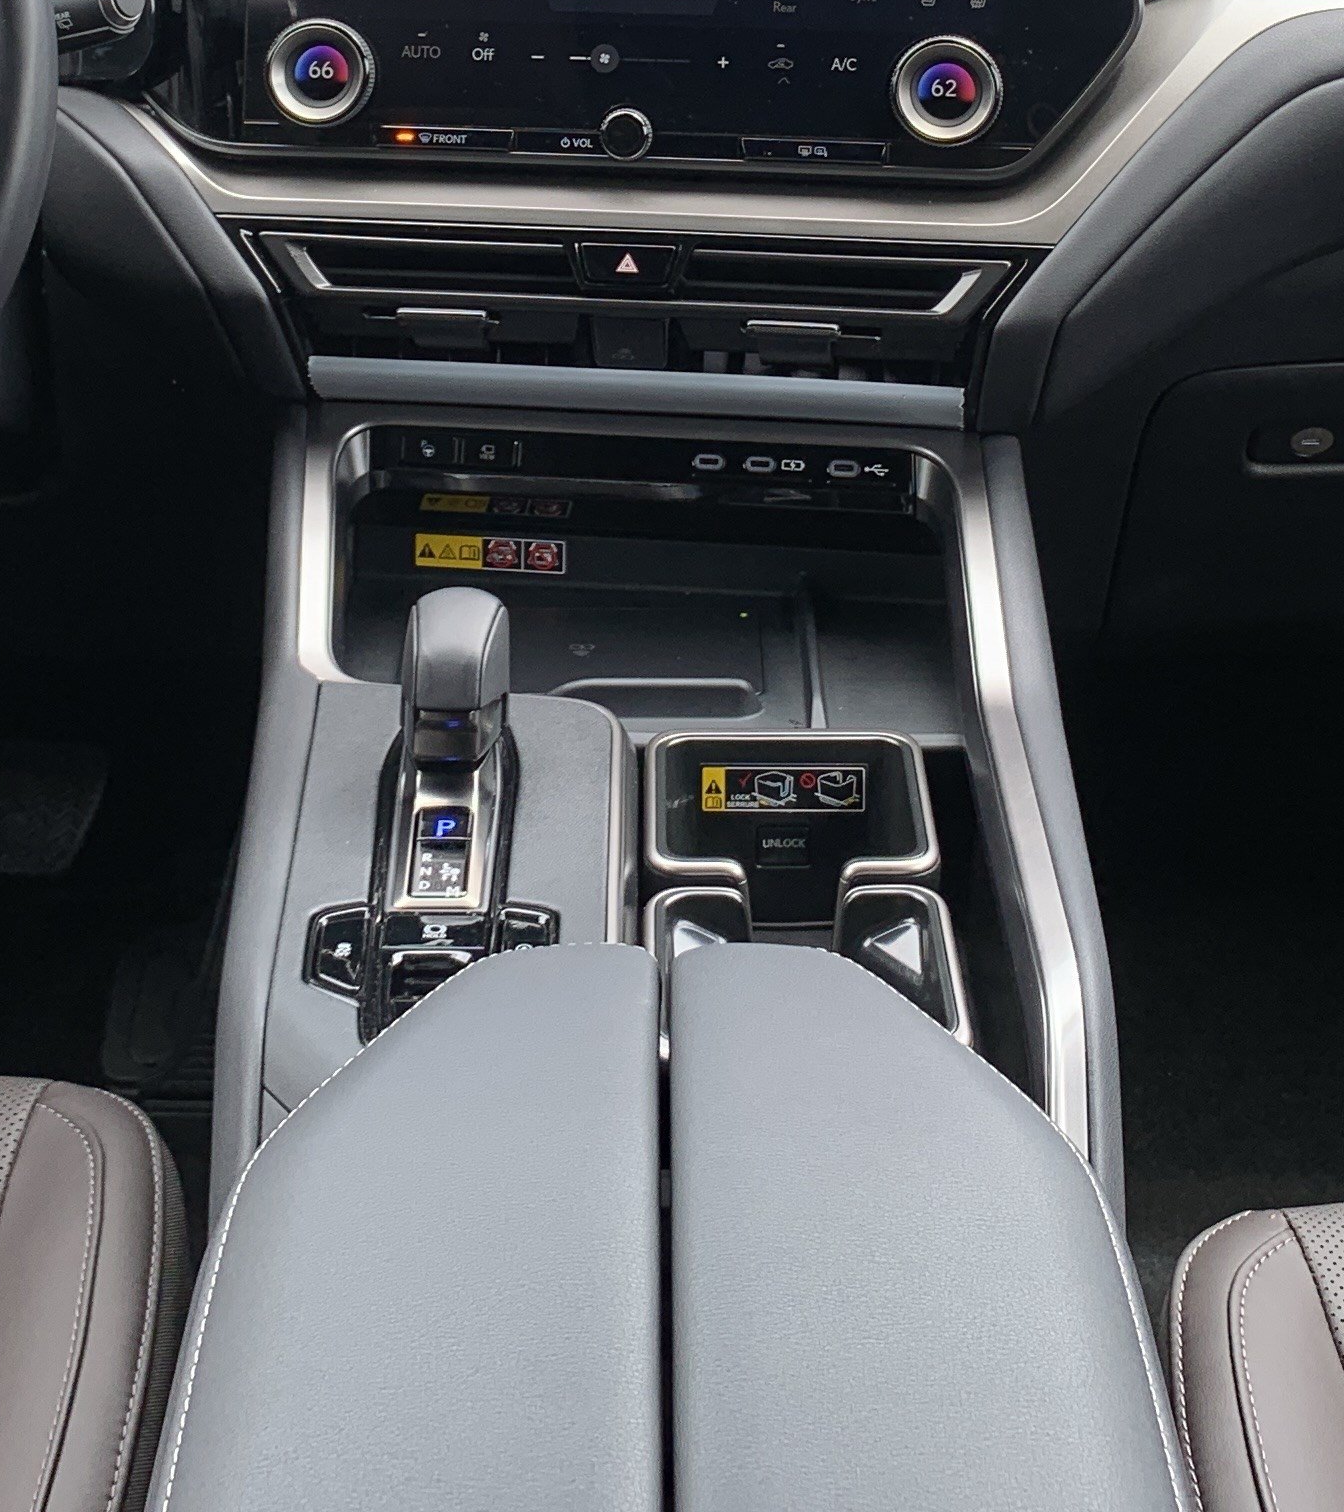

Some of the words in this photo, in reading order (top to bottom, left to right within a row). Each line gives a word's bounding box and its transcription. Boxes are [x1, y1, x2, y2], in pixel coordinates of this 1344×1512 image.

[773, 1, 798, 13] Rear
[401, 45, 442, 59] AUTO
[471, 47, 496, 62] Off
[307, 60, 335, 80] 66
[830, 57, 858, 72] A/C
[930, 78, 958, 98] 62
[432, 133, 468, 144] FRONT
[571, 138, 594, 148] VOL
[730, 793, 751, 801] LOCK
[436, 819, 456, 838] P
[762, 838, 806, 849] UNLOCK
[422, 852, 433, 862] R
[419, 867, 433, 876] N
[418, 880, 431, 889] D
